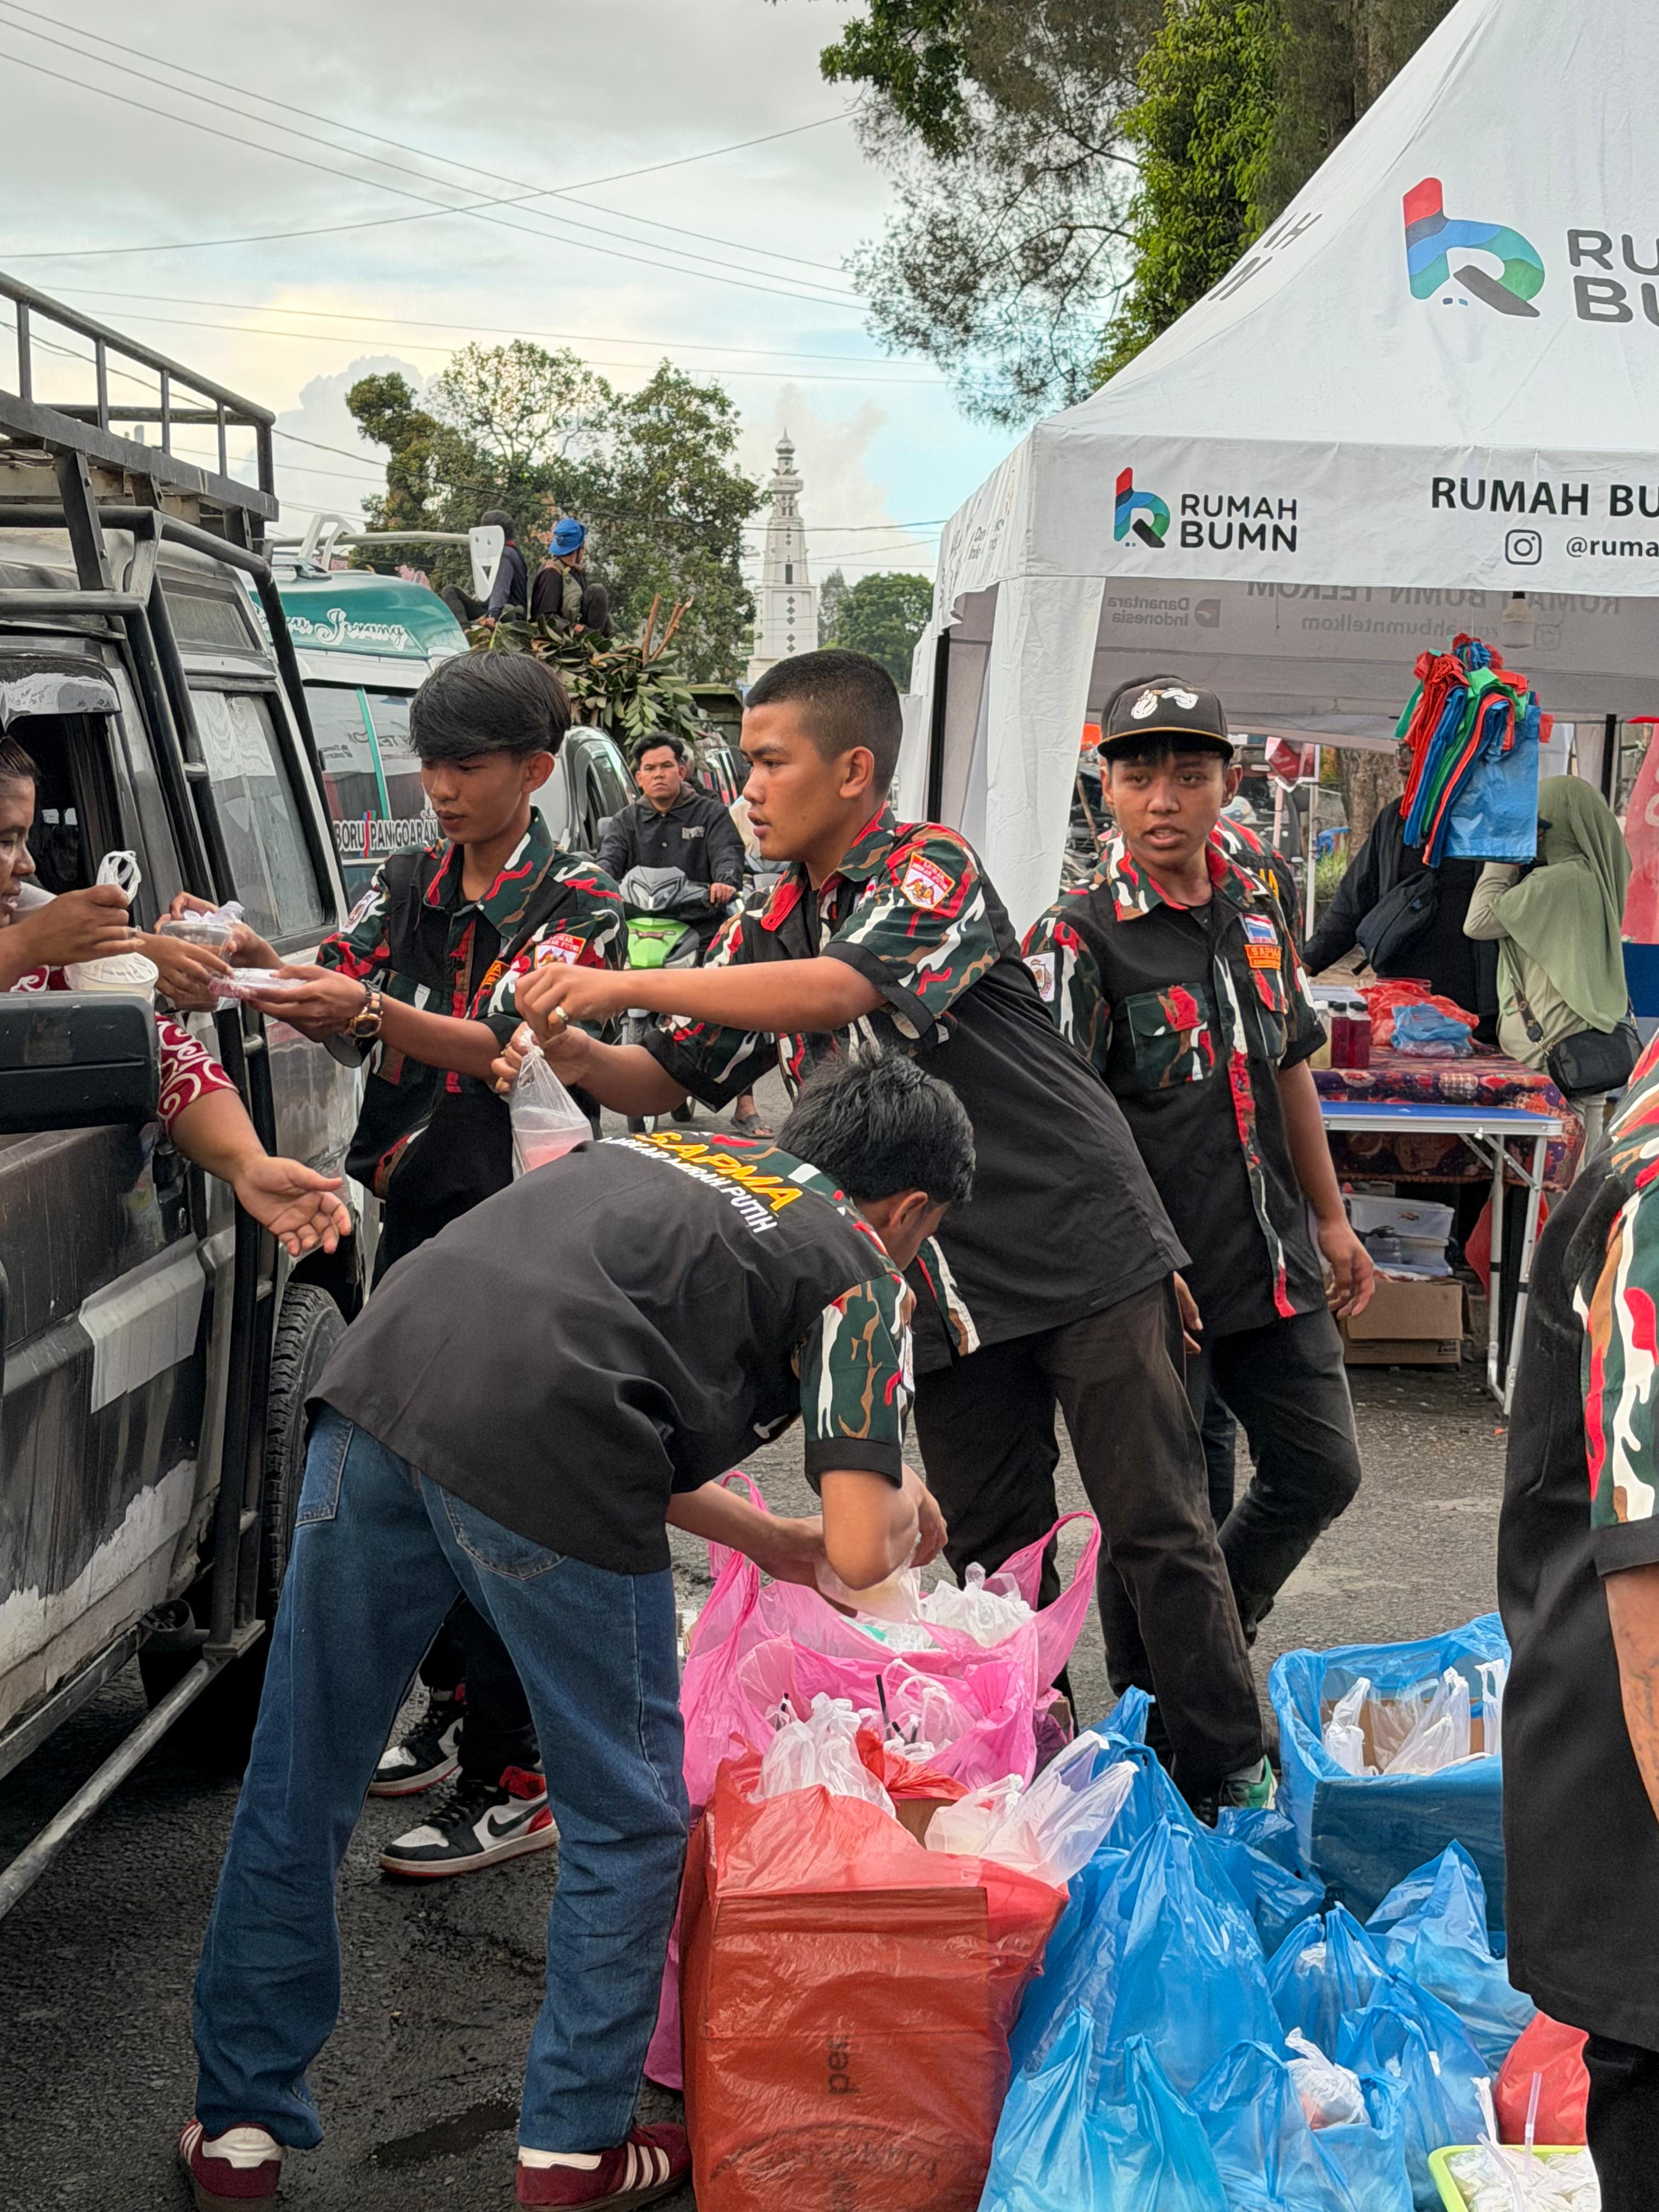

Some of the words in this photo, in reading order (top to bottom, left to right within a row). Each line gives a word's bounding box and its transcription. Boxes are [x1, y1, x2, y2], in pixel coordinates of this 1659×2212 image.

[1181, 494, 1297, 521] RUMAH
[1432, 477, 1589, 516] RUMAH
[1609, 484, 1659, 518] BU
[1180, 521, 1297, 552] BUMN
[1566, 537, 1659, 558] @ruma
[334, 821, 366, 851] BORU
[369, 819, 438, 850] PANGOARAN
[634, 1131, 803, 1211] SAPMA
[719, 1186, 778, 1233] PUTIH
